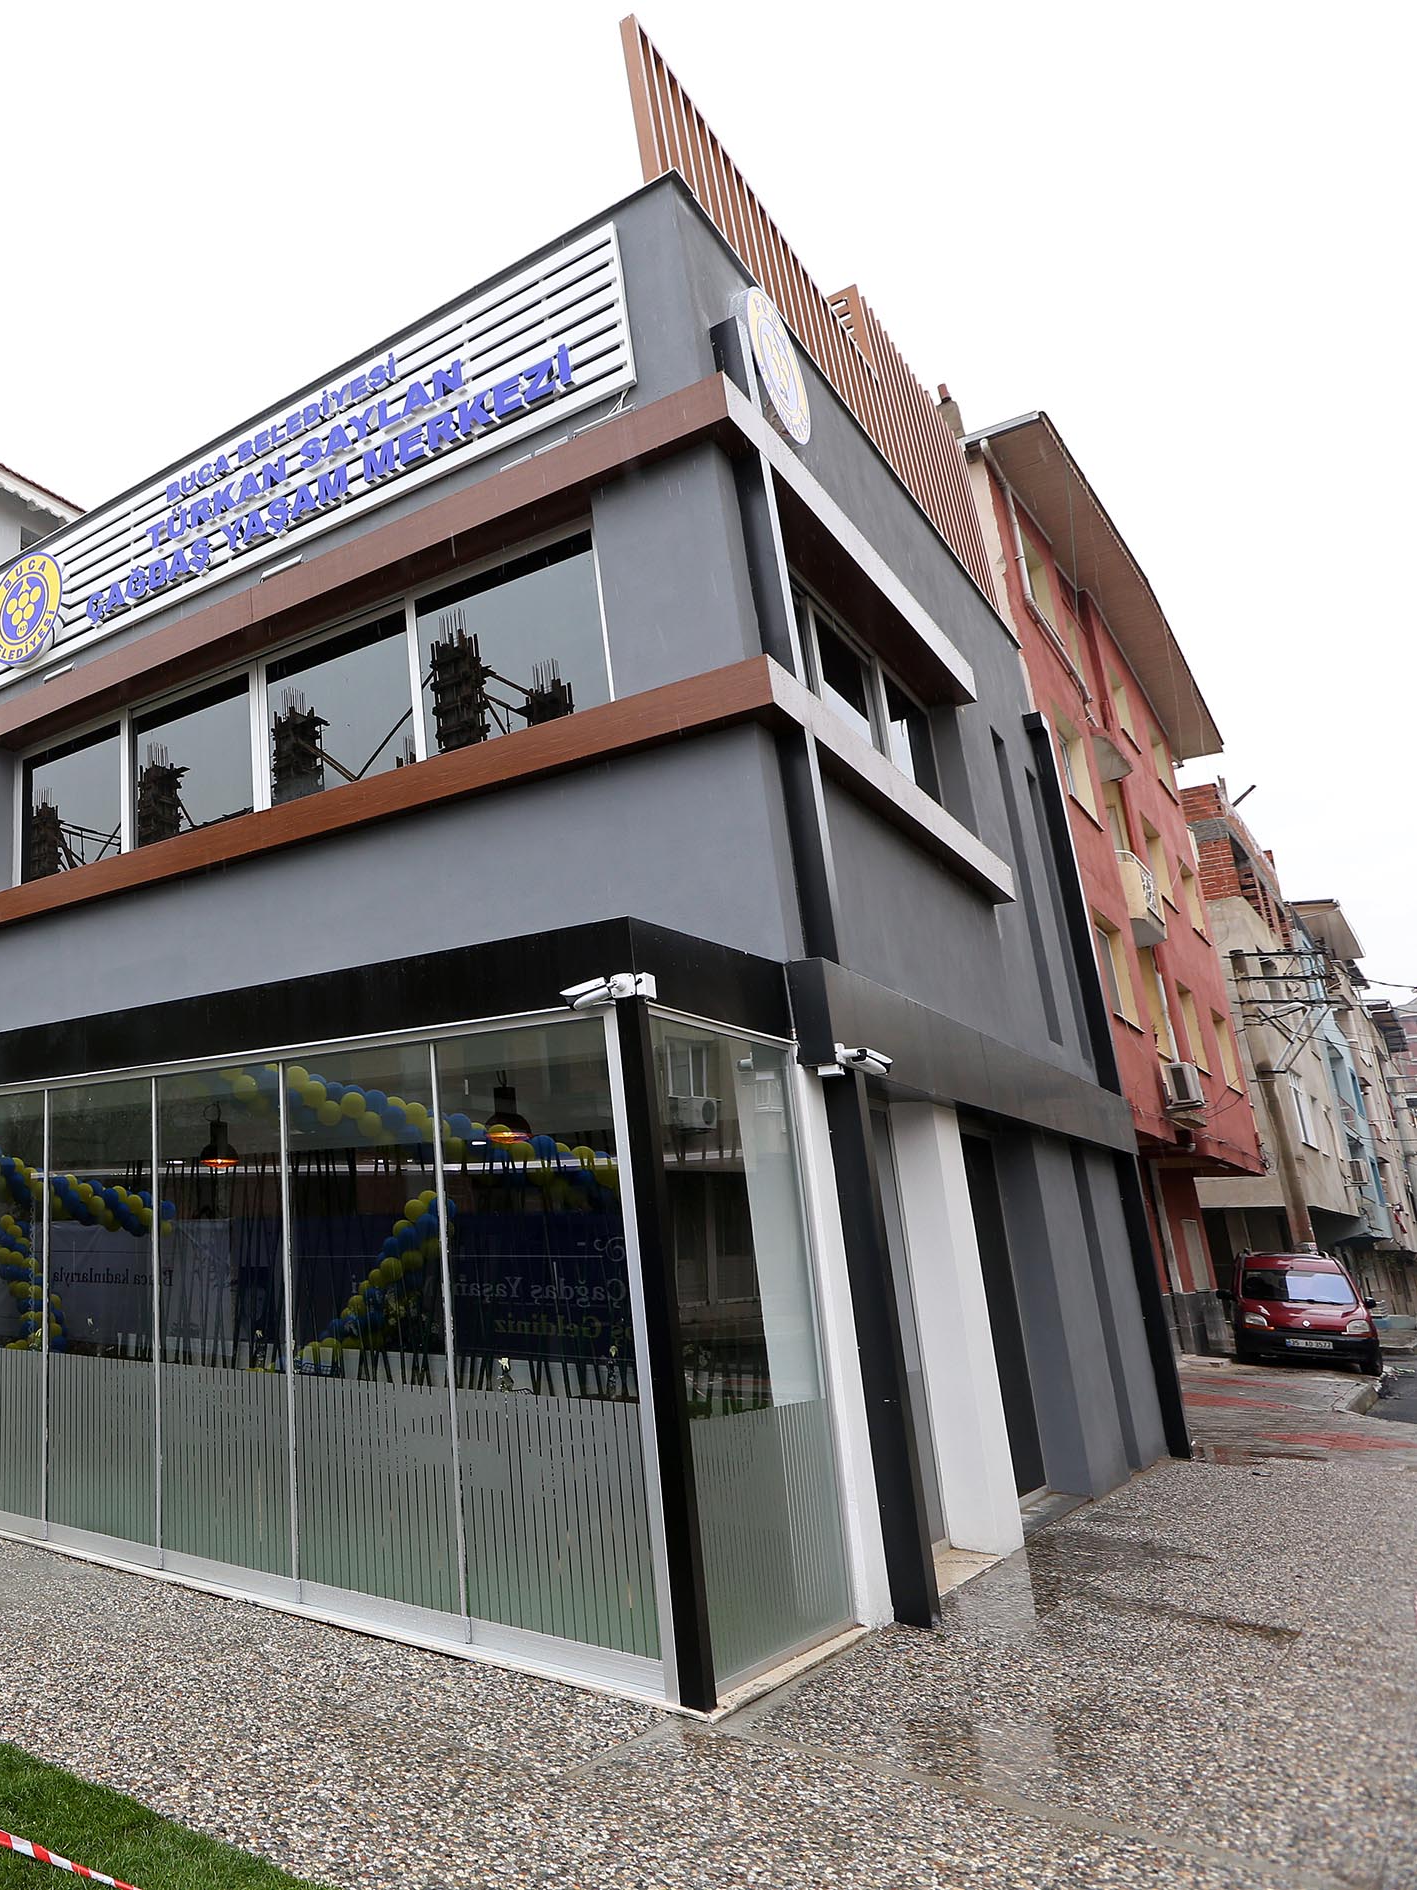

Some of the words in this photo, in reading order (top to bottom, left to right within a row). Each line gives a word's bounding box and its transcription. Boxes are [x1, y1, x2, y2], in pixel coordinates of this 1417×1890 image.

[85, 537, 210, 626] ÇAĞDAŞ
[220, 463, 349, 550] YAŞAM
[362, 342, 572, 482] MERKEZİ
[145, 454, 287, 550] TÜRKAN
[300, 358, 463, 469] SAYLAN
[165, 454, 230, 503] BUCA
[237, 352, 397, 463] BELEDİYESİ
[3, 559, 47, 590] BUCA
